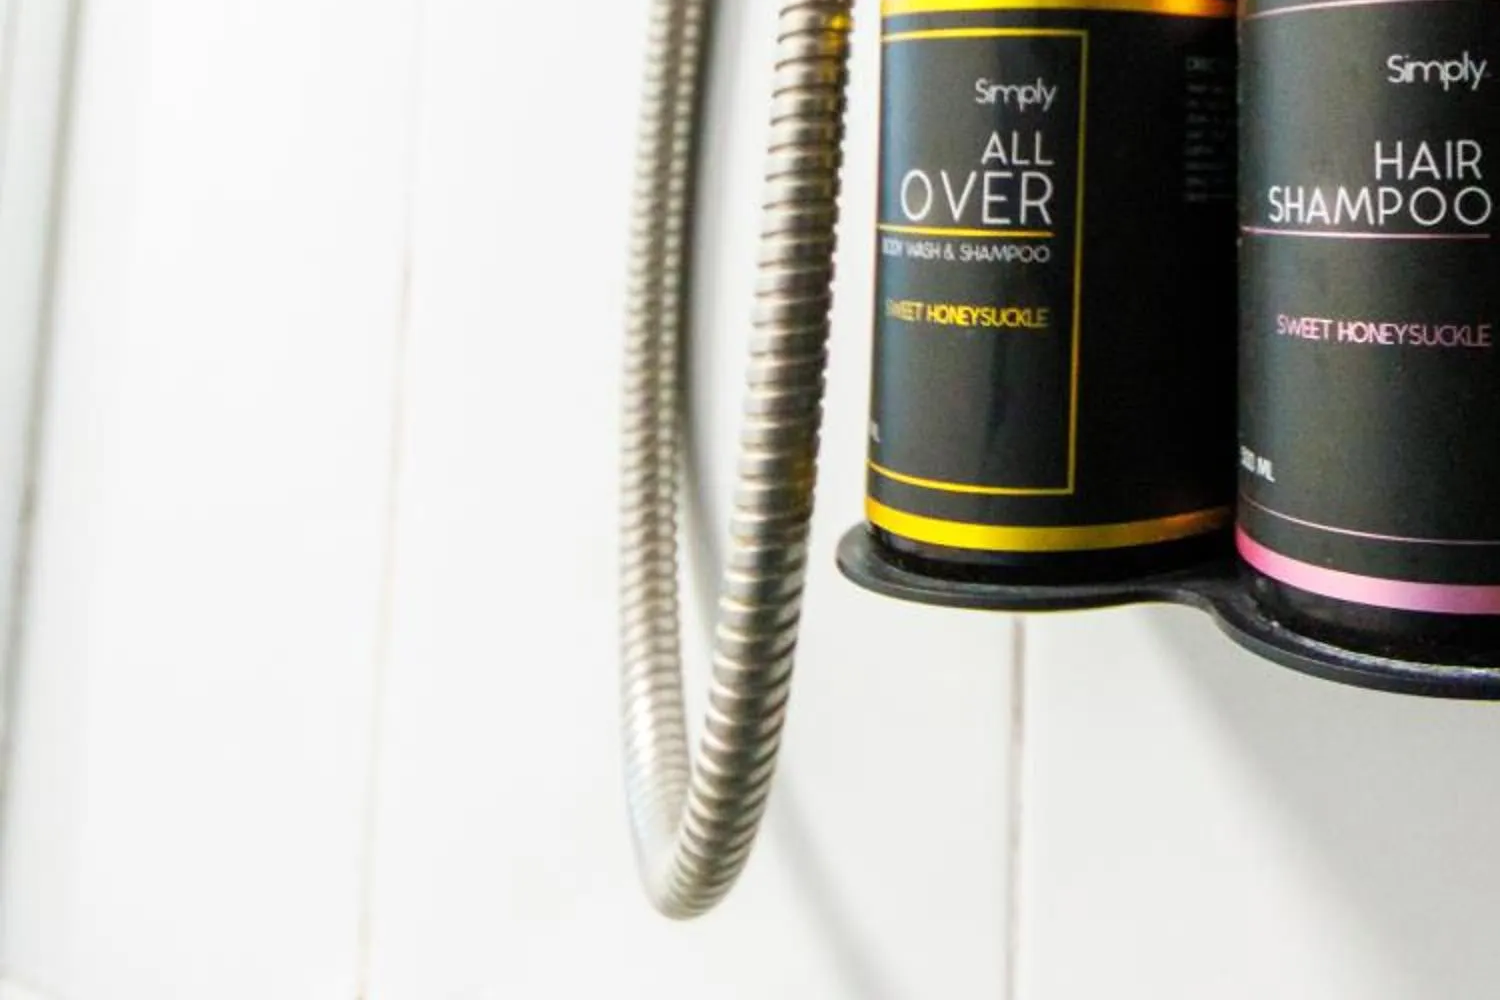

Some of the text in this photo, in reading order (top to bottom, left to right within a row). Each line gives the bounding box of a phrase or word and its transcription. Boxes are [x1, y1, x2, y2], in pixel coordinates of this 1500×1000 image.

[1386, 50, 1488, 91] Simply
[975, 77, 1057, 112] Simply
[980, 130, 1055, 166] ALL
[1374, 140, 1483, 181] HAIR
[900, 169, 1054, 225] OVER
[1267, 184, 1493, 227] SHAMPOO
[943, 241, 957, 263] &
[959, 242, 1051, 264] SHAMPOO
[925, 303, 1050, 329] HONEYSUCKLE
[1276, 314, 1493, 348] SWEET HONEYSUCKLE
